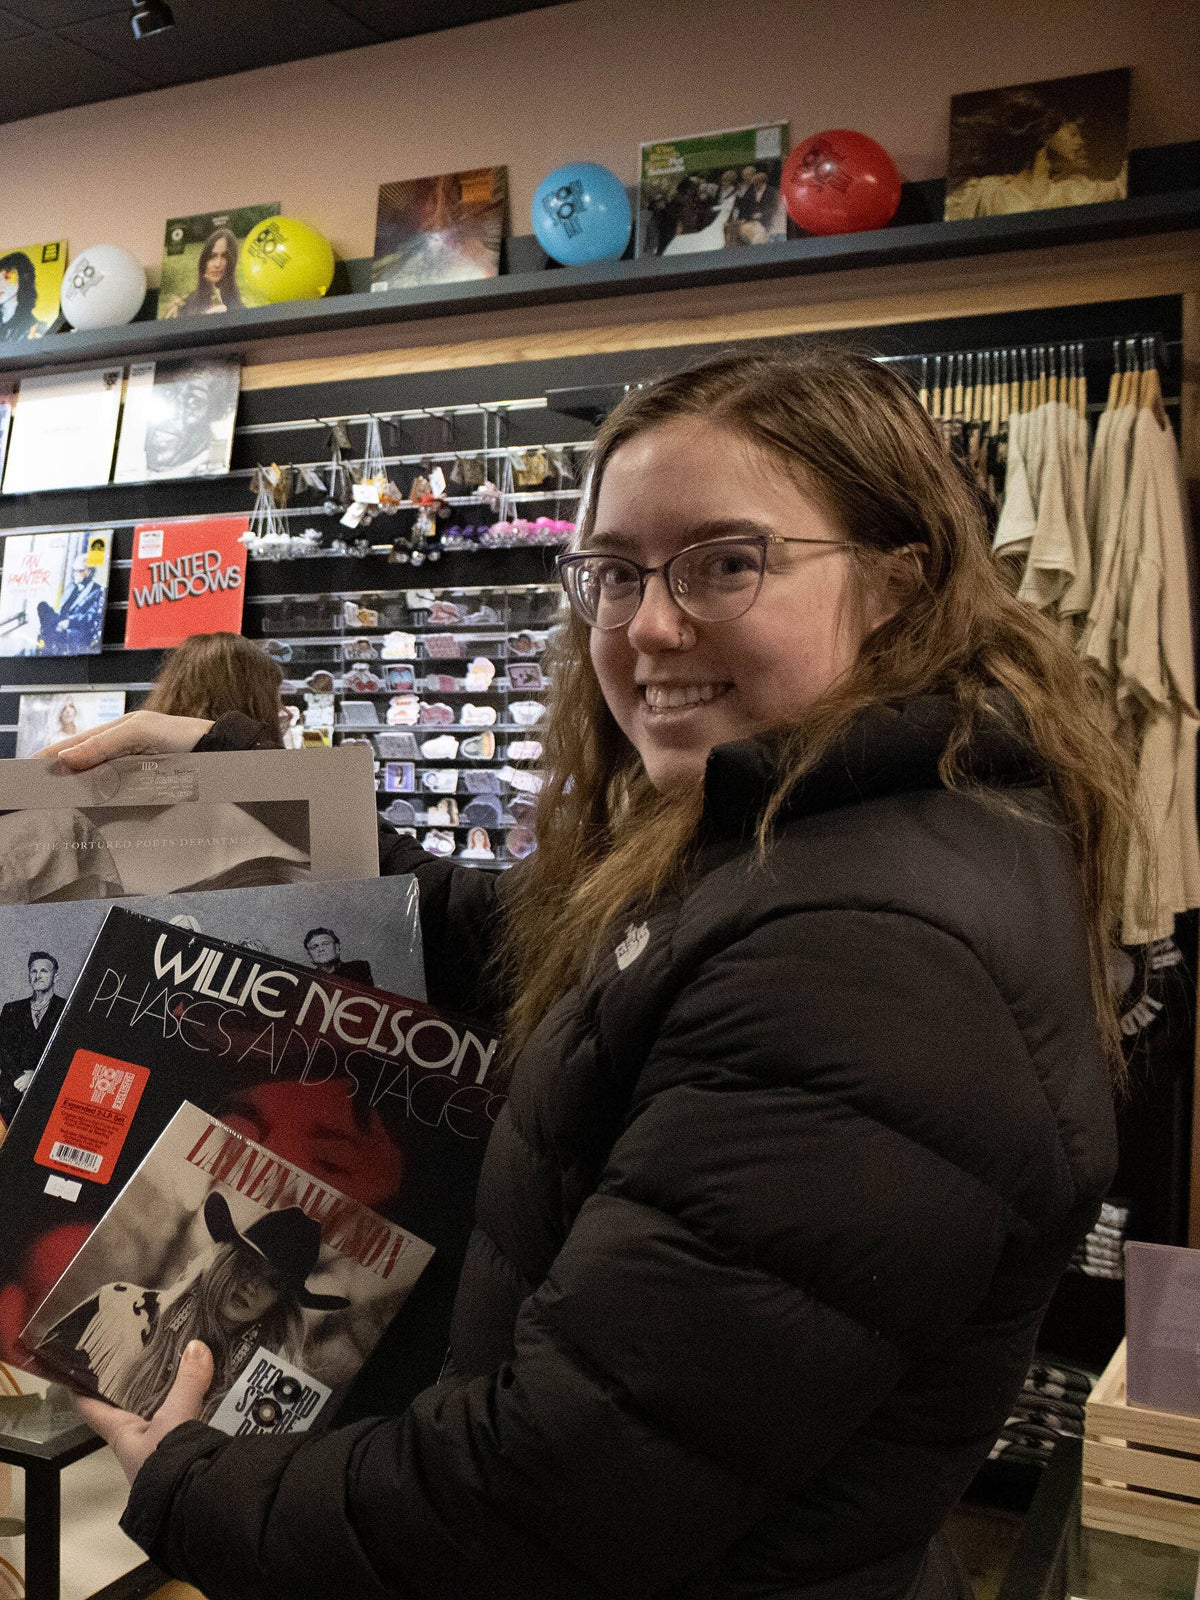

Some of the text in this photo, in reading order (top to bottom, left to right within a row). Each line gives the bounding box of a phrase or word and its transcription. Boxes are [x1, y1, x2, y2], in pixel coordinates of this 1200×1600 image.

[133, 565, 241, 609] WINDOWS
[148, 550, 221, 583] TINTED
[63, 840, 131, 851] TORTURED
[136, 839, 175, 849] POETS
[180, 836, 260, 848] DEPARTMEN
[88, 967, 247, 1057] PHASES
[237, 1022, 338, 1086] AND
[153, 933, 499, 1085] WILLIE NELSON
[63, 1099, 97, 1115] Expanded
[113, 1113, 126, 1124] Set
[184, 1123, 300, 1211] LAINEY
[301, 1181, 415, 1280] WILSON
[235, 1386, 300, 1434] STORE
[247, 1358, 321, 1419] RECORD
